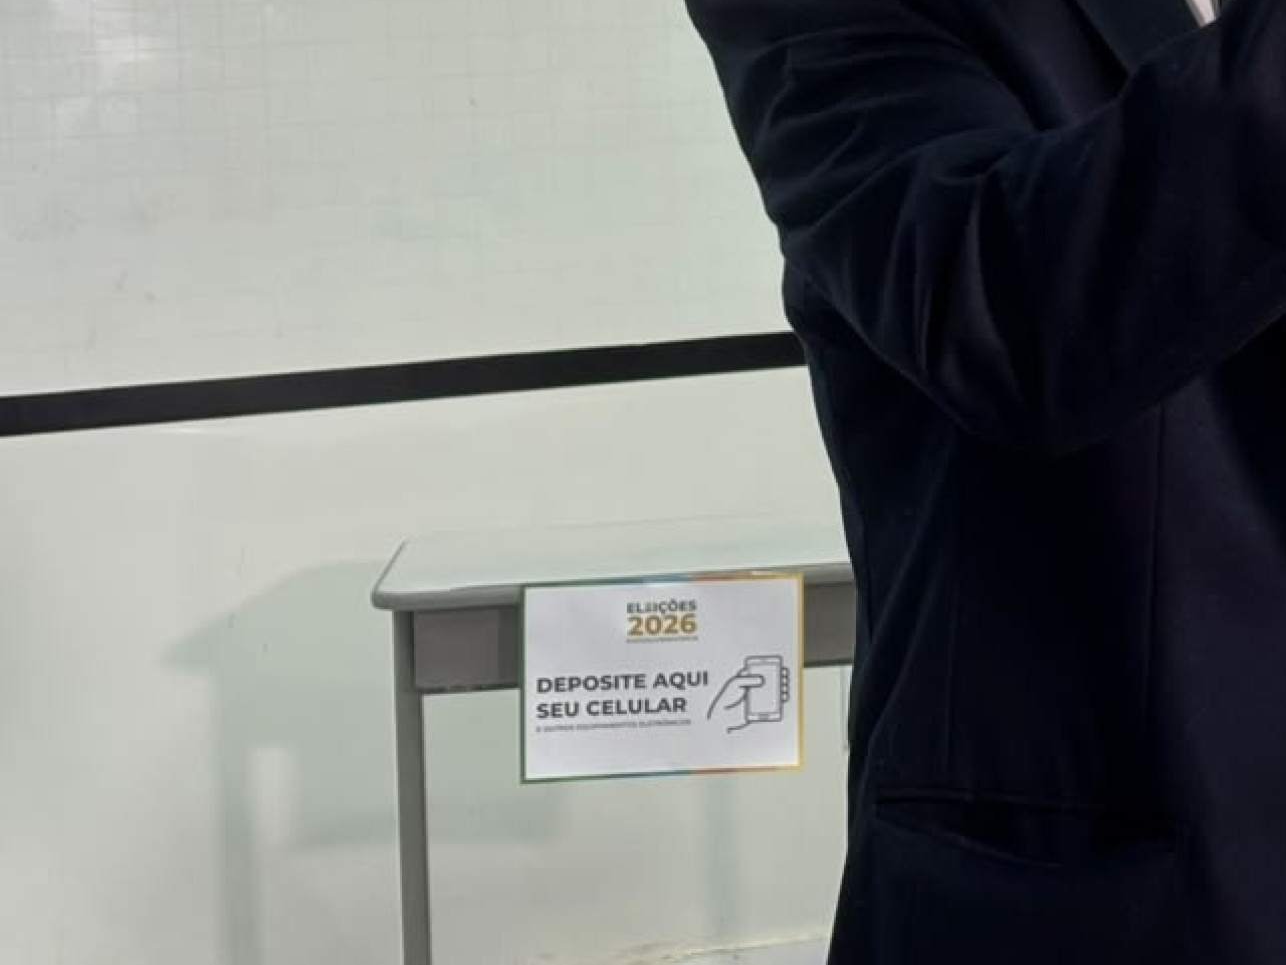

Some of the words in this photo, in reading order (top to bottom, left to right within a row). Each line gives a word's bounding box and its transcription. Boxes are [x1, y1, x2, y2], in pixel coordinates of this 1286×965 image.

[626, 598, 698, 615] ELEIÇÕES
[626, 612, 698, 637] 2026
[536, 673, 648, 694] DEPOSITE
[652, 670, 708, 691] AQUI
[536, 701, 580, 719] SEU
[586, 696, 688, 717] CELULAR
